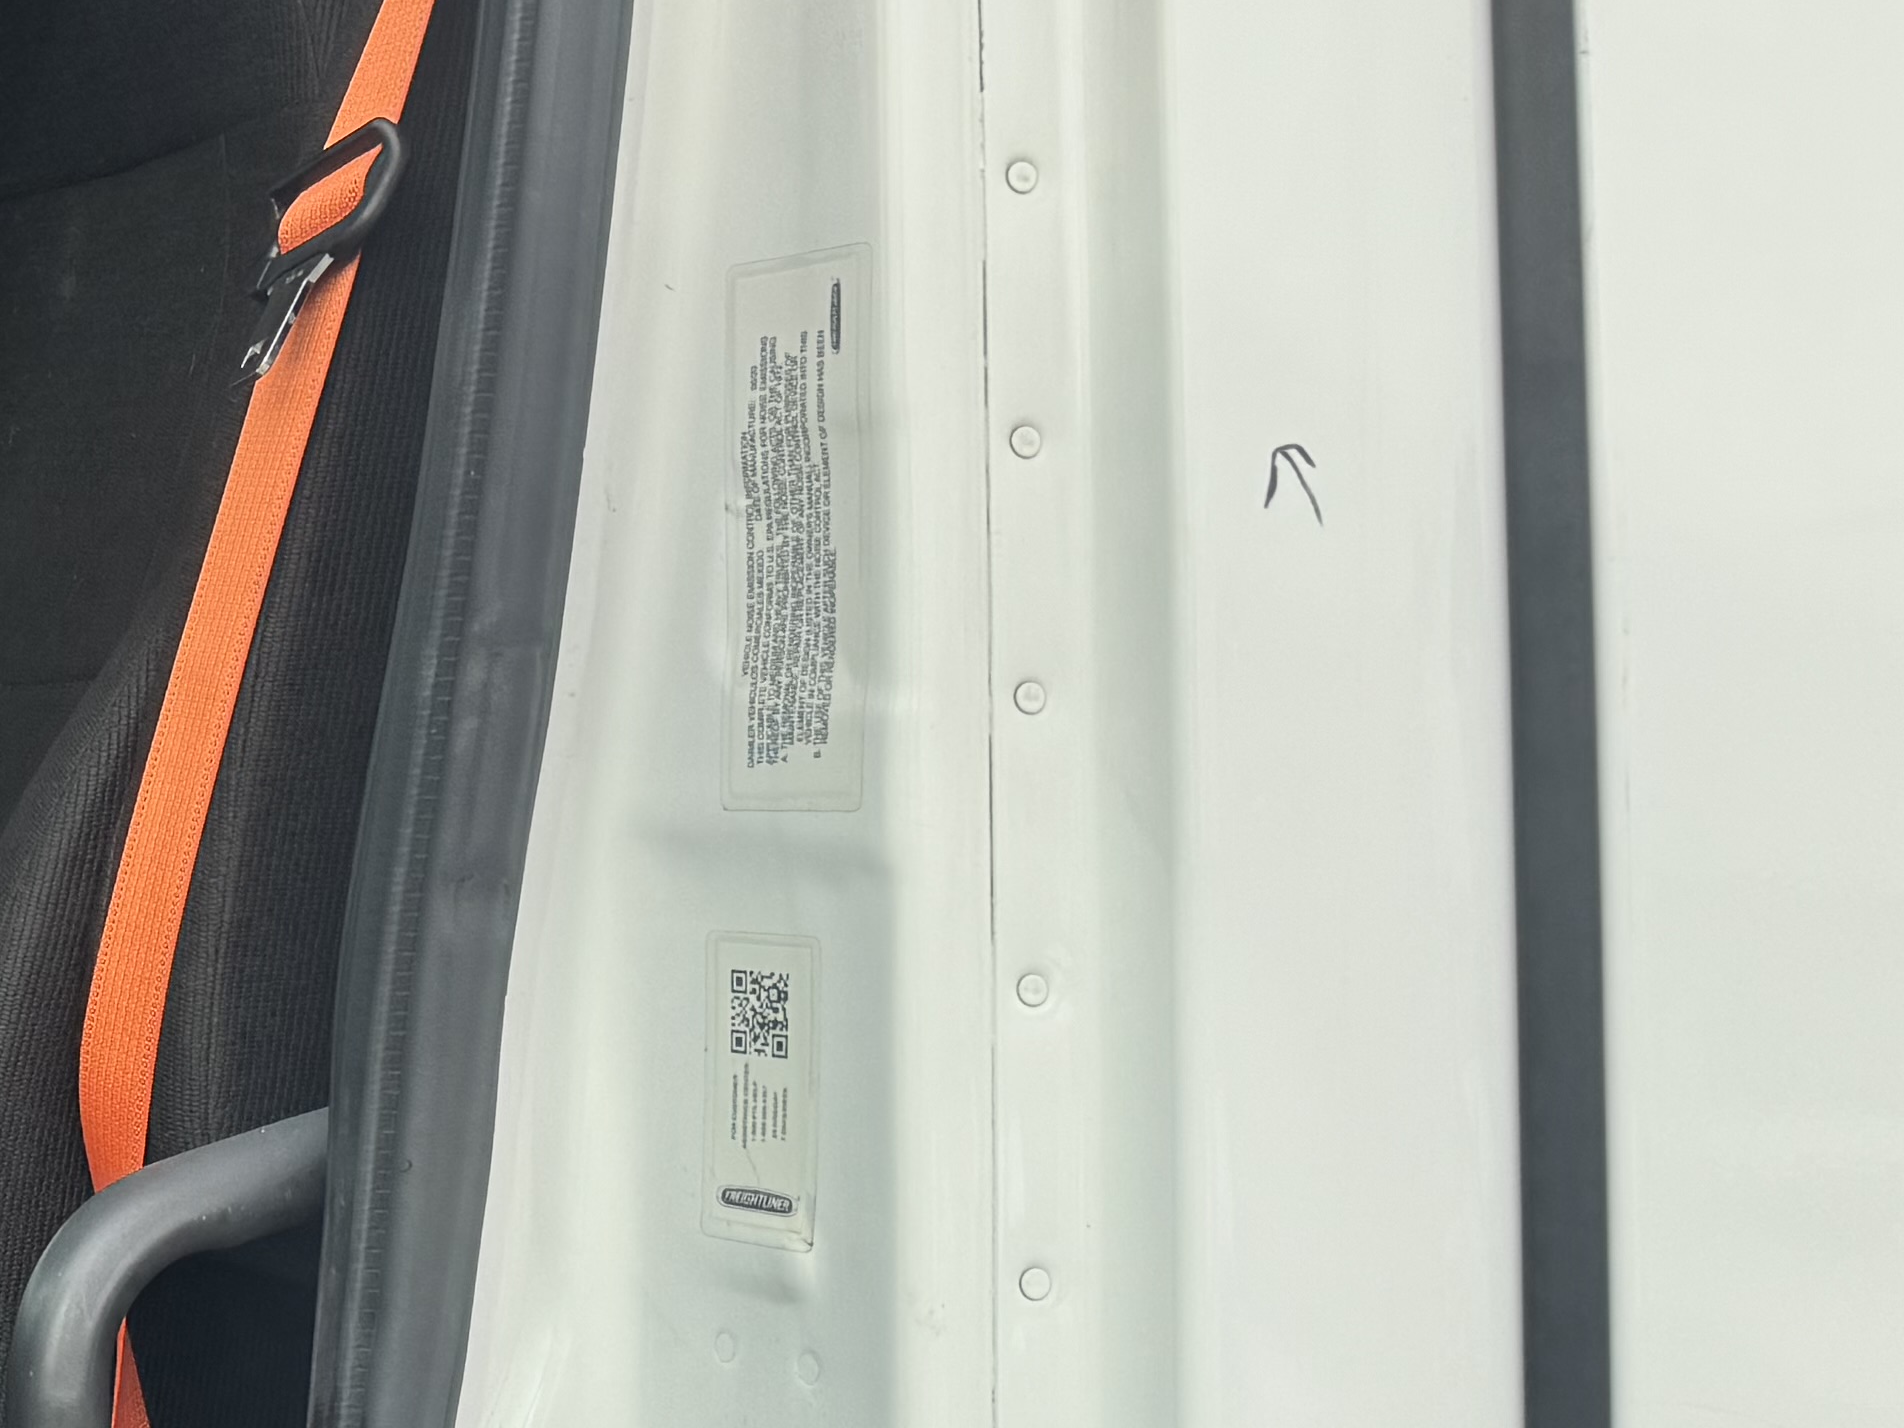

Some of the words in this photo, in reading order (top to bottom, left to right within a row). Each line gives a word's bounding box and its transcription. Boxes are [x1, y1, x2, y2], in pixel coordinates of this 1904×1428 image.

[759, 394, 767, 423] NOISE
[759, 427, 768, 447] FOR
[751, 481, 759, 493] OF
[753, 496, 762, 521] DATE
[746, 504, 754, 550] CONTROL
[766, 565, 773, 578] TO
[742, 636, 752, 676] VEHICLE
[725, 1191, 790, 1211] FREIGHTLINER
